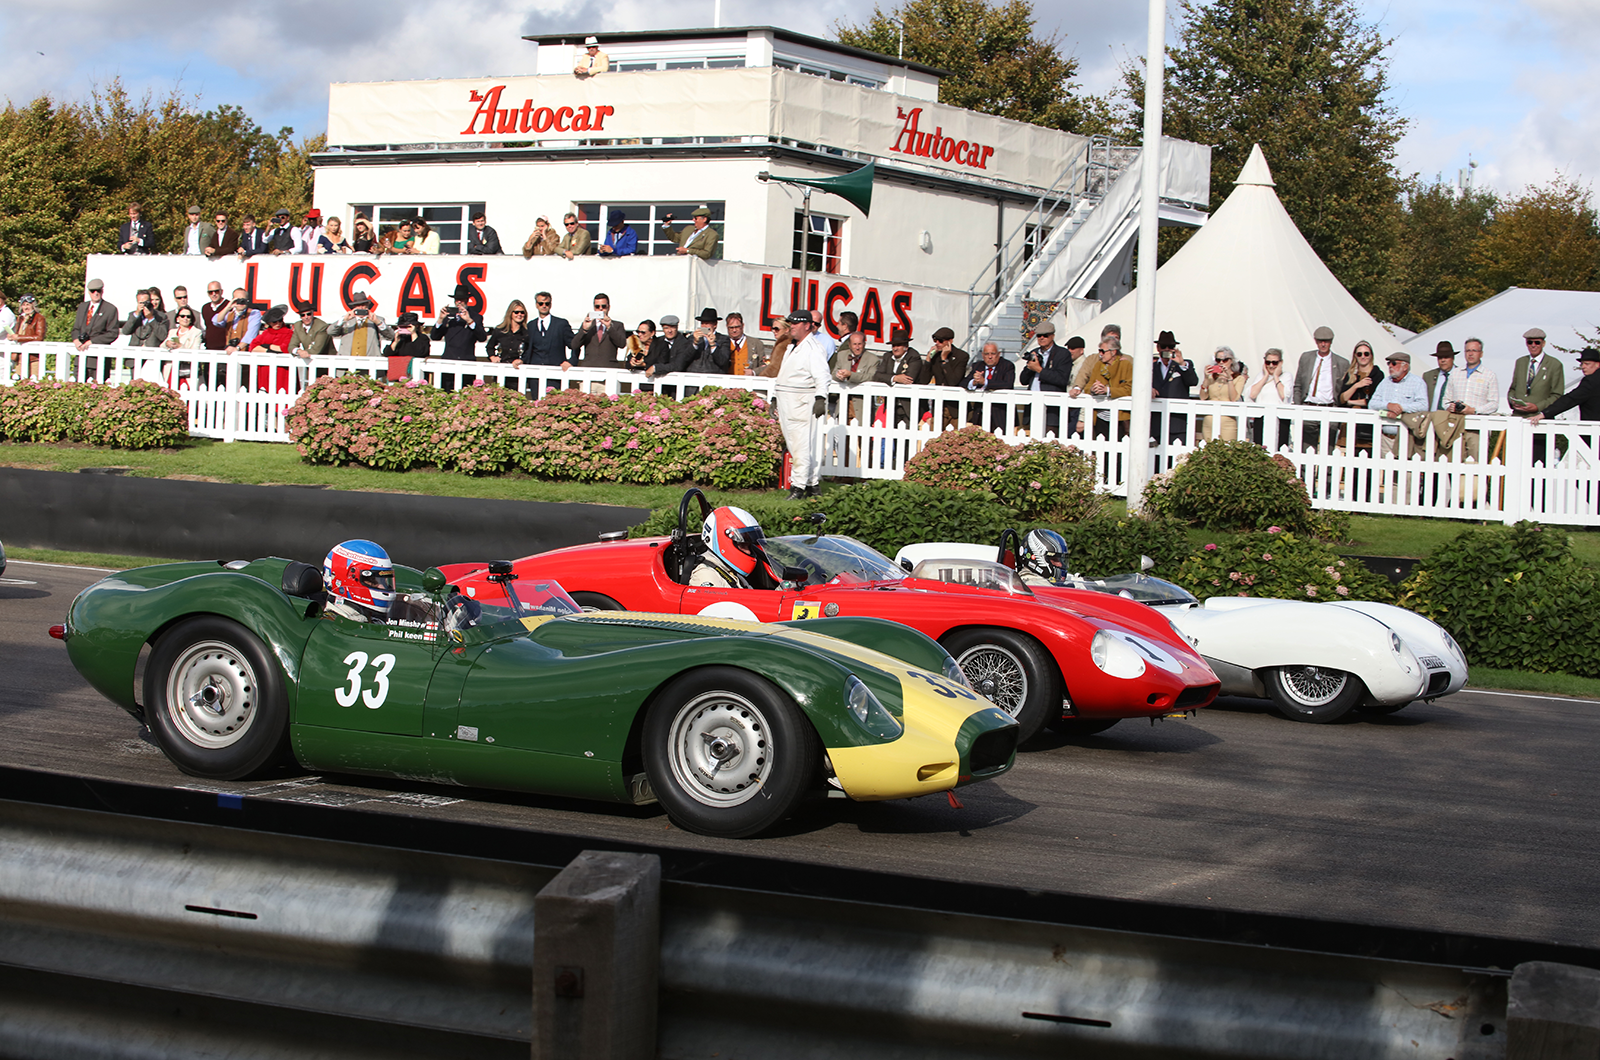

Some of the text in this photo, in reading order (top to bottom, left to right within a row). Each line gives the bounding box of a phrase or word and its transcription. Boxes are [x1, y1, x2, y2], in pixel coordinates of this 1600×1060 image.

[460, 85, 615, 135] Autocar
[889, 107, 994, 170] Autocar
[244, 260, 488, 318] LUCAS
[759, 273, 913, 343] LUCAS
[386, 617, 398, 626] Jon
[388, 629, 403, 639] Phil
[334, 651, 396, 709] 33
